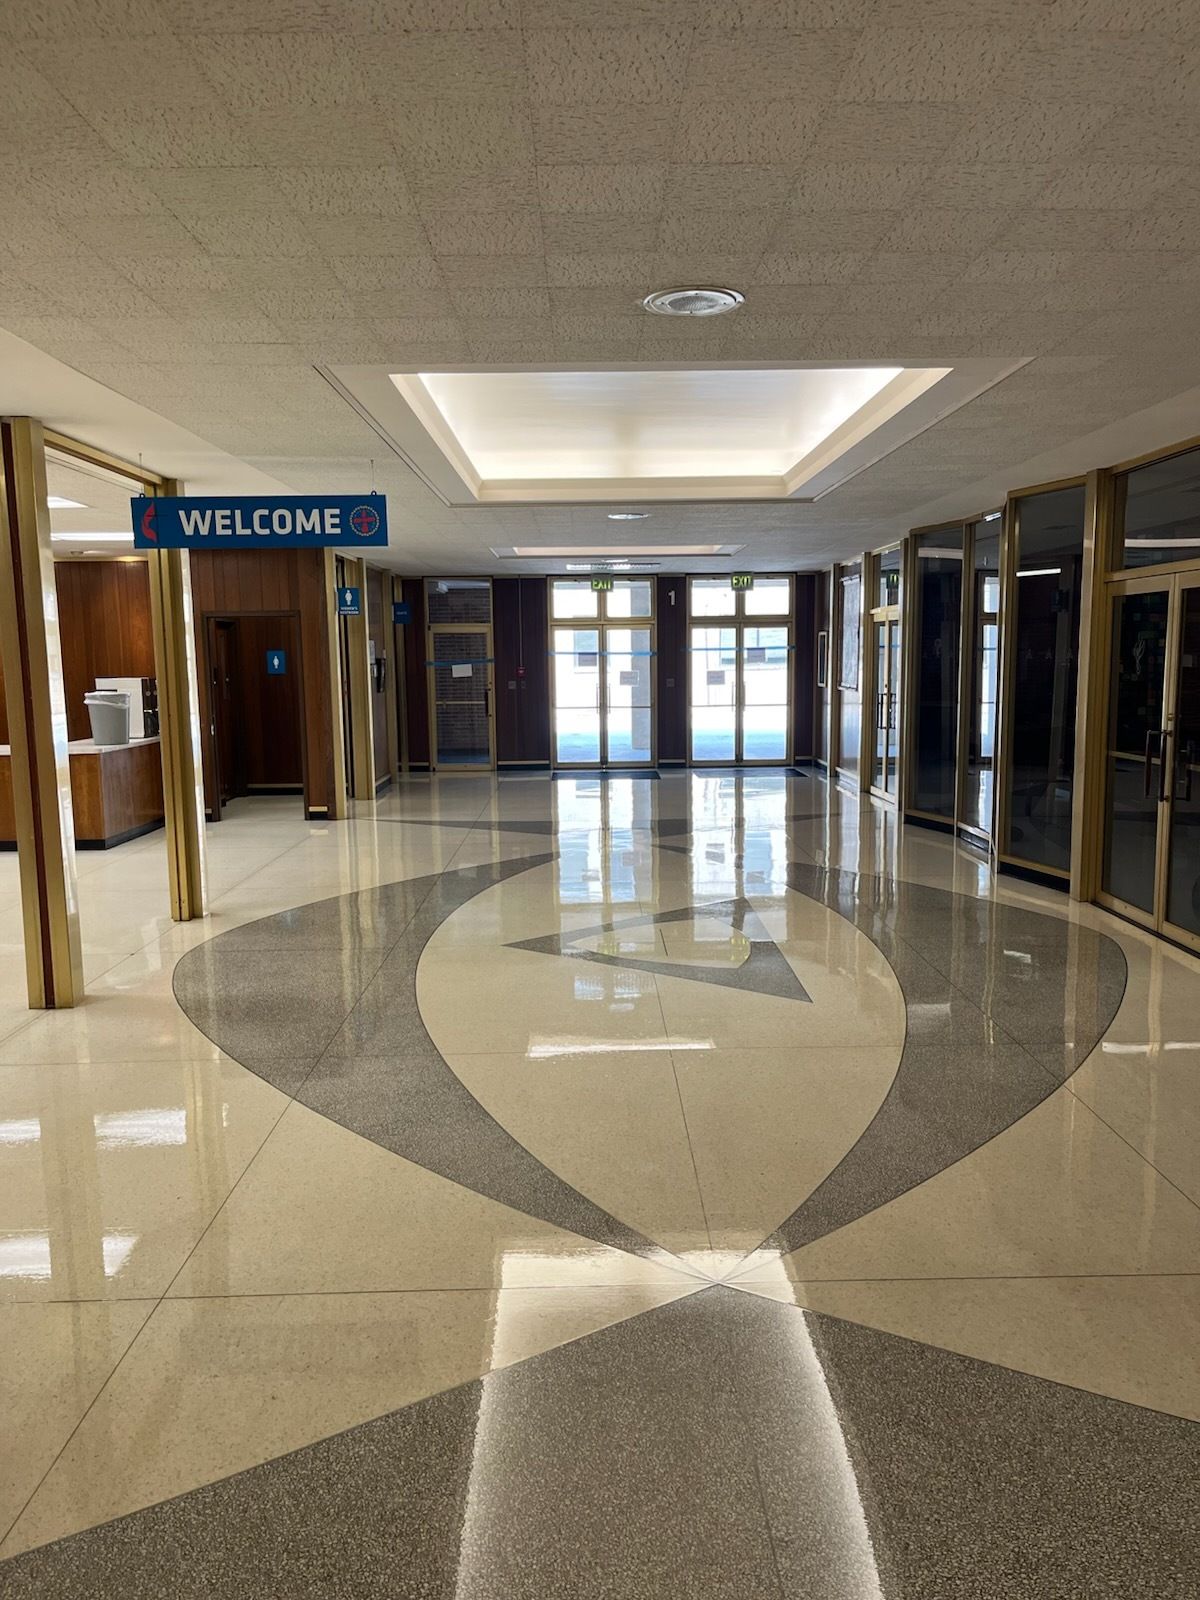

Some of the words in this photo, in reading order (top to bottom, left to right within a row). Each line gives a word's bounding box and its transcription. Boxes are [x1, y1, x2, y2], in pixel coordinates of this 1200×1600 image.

[178, 508, 342, 536] WELCOME
[592, 578, 611, 590] EXIT
[732, 576, 752, 588] EXIT
[667, 590, 676, 606] 1
